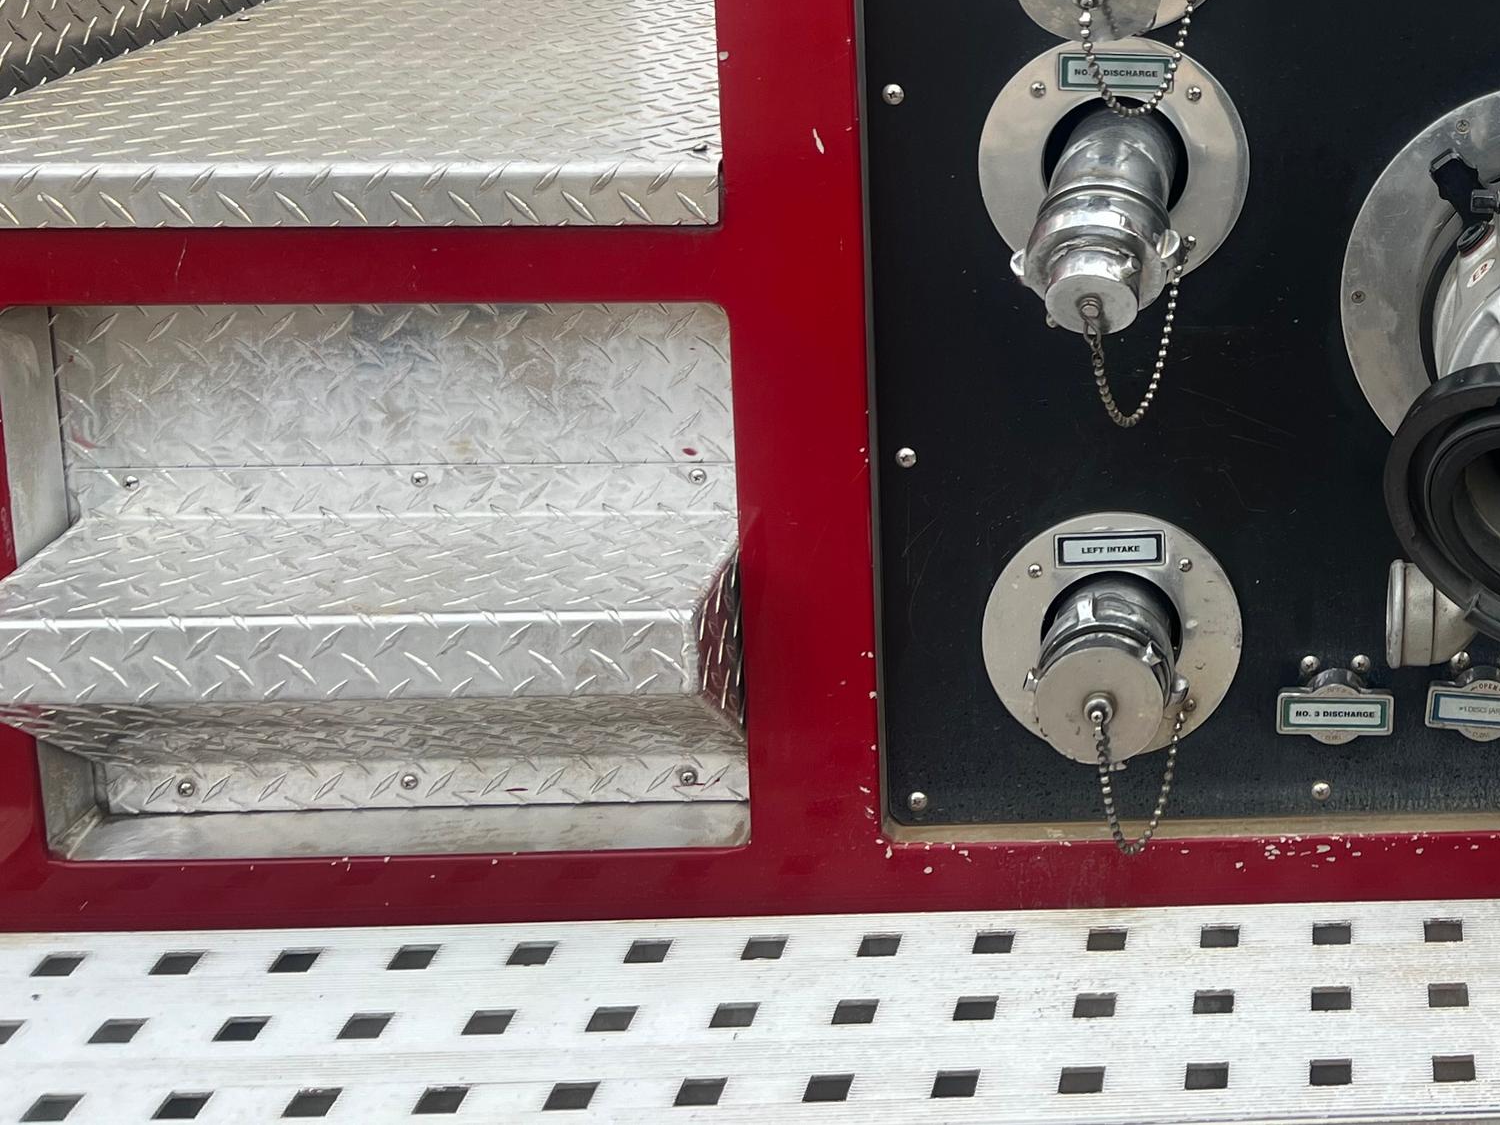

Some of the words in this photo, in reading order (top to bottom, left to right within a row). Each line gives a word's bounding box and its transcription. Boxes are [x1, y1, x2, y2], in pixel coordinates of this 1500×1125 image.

[1103, 69, 1158, 78] DISCHARGE
[1081, 546, 1105, 554] LEFT
[1107, 545, 1140, 553] INTAKE
[1478, 683, 1498, 691] OPEN
[1322, 710, 1375, 718] DISCHARGE
